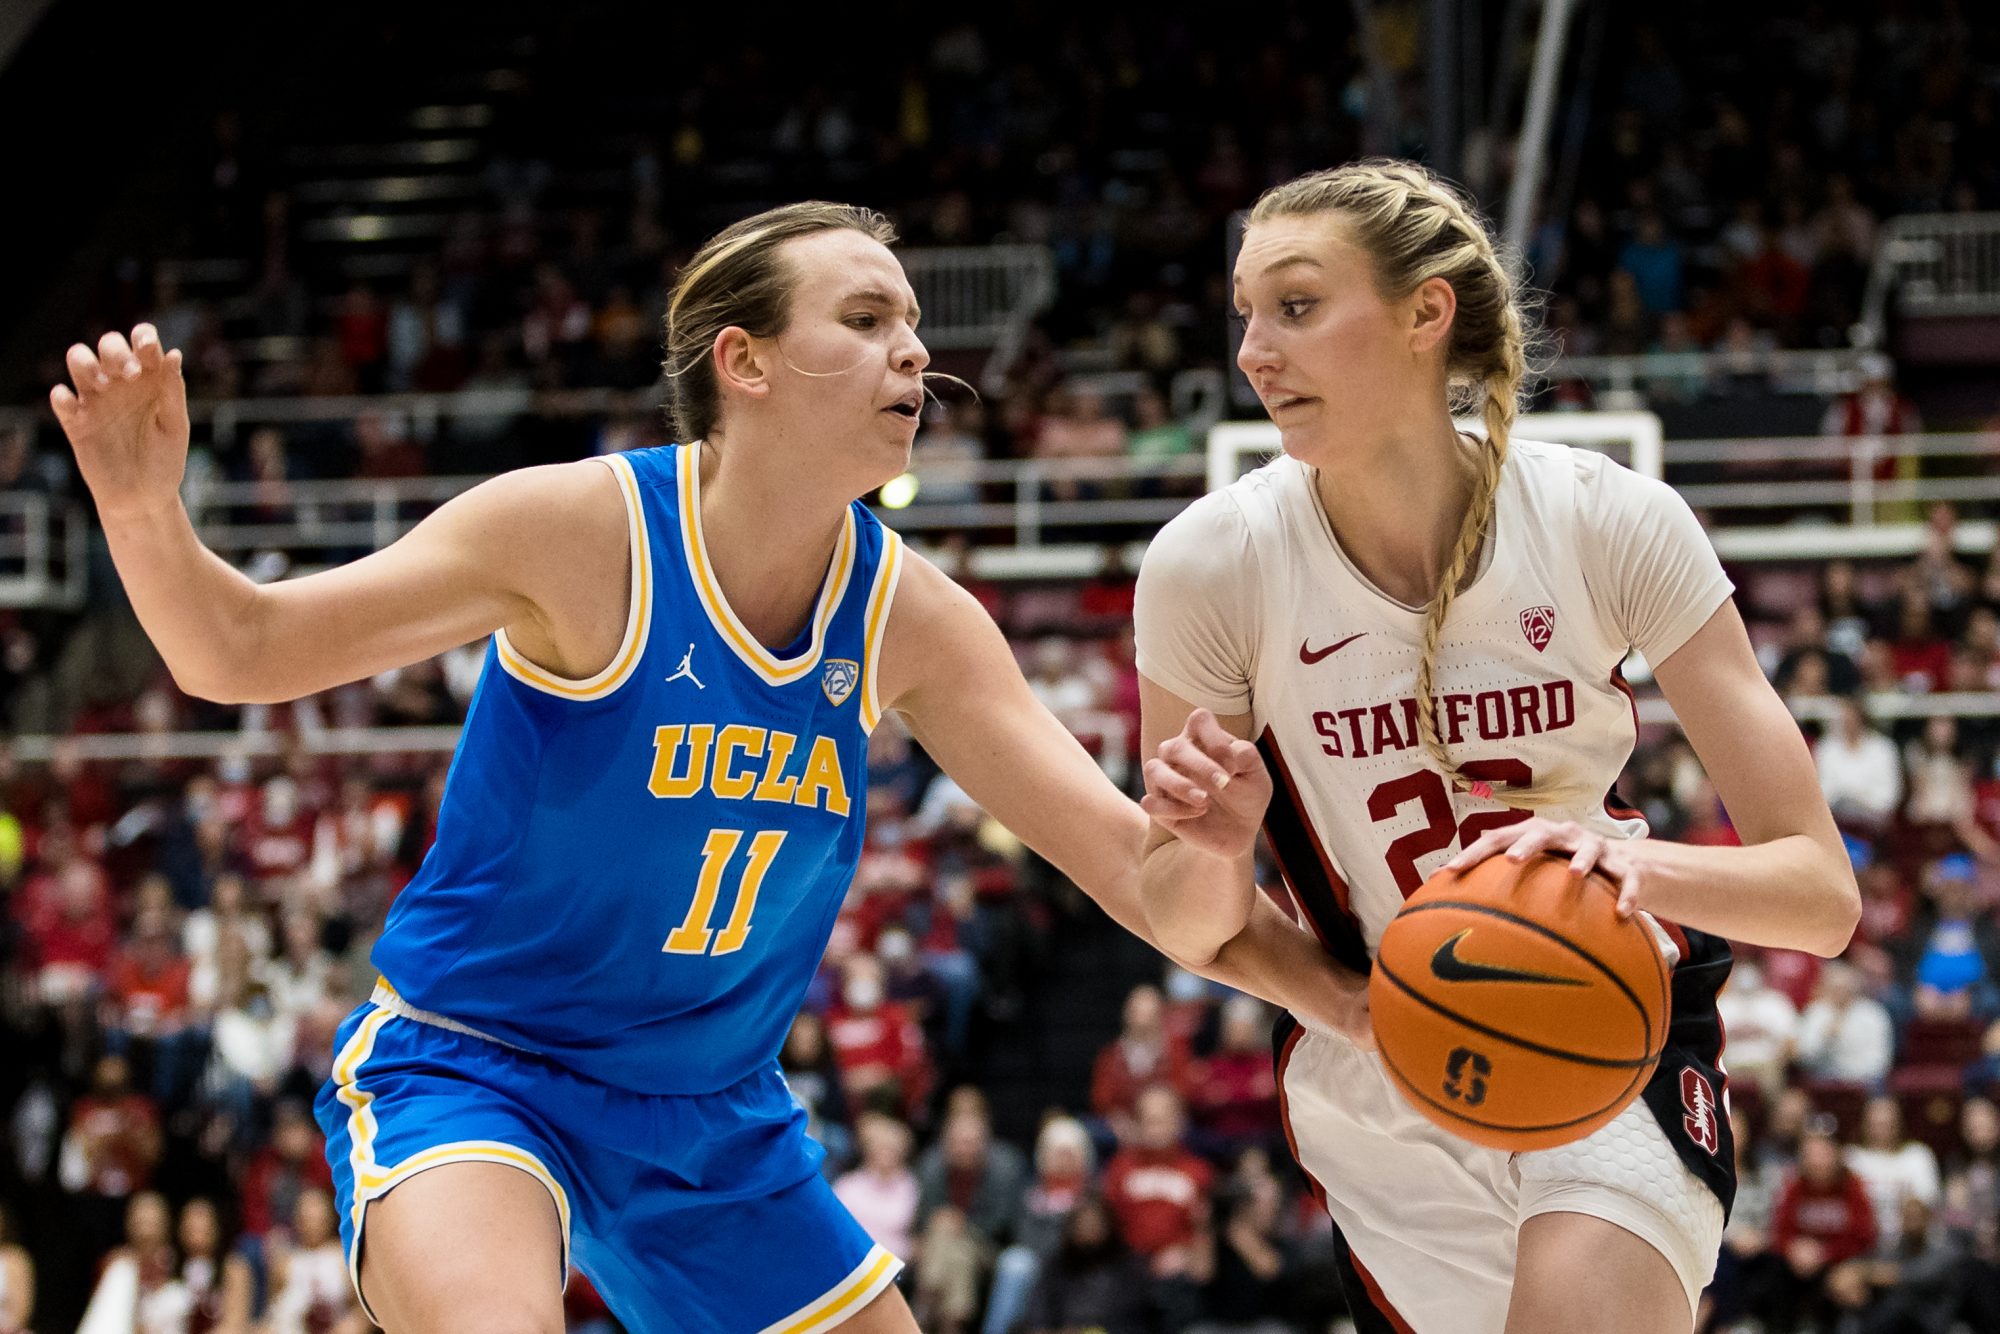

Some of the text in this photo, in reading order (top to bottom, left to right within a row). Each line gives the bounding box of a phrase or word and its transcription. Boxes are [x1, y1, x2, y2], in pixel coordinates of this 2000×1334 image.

[1521, 607, 1554, 636] PAC
[1530, 624, 1548, 644] 12
[828, 678, 846, 696] 12
[1312, 680, 1575, 759] STANFORD
[647, 723, 852, 818] UCLA
[661, 828, 790, 957] 11
